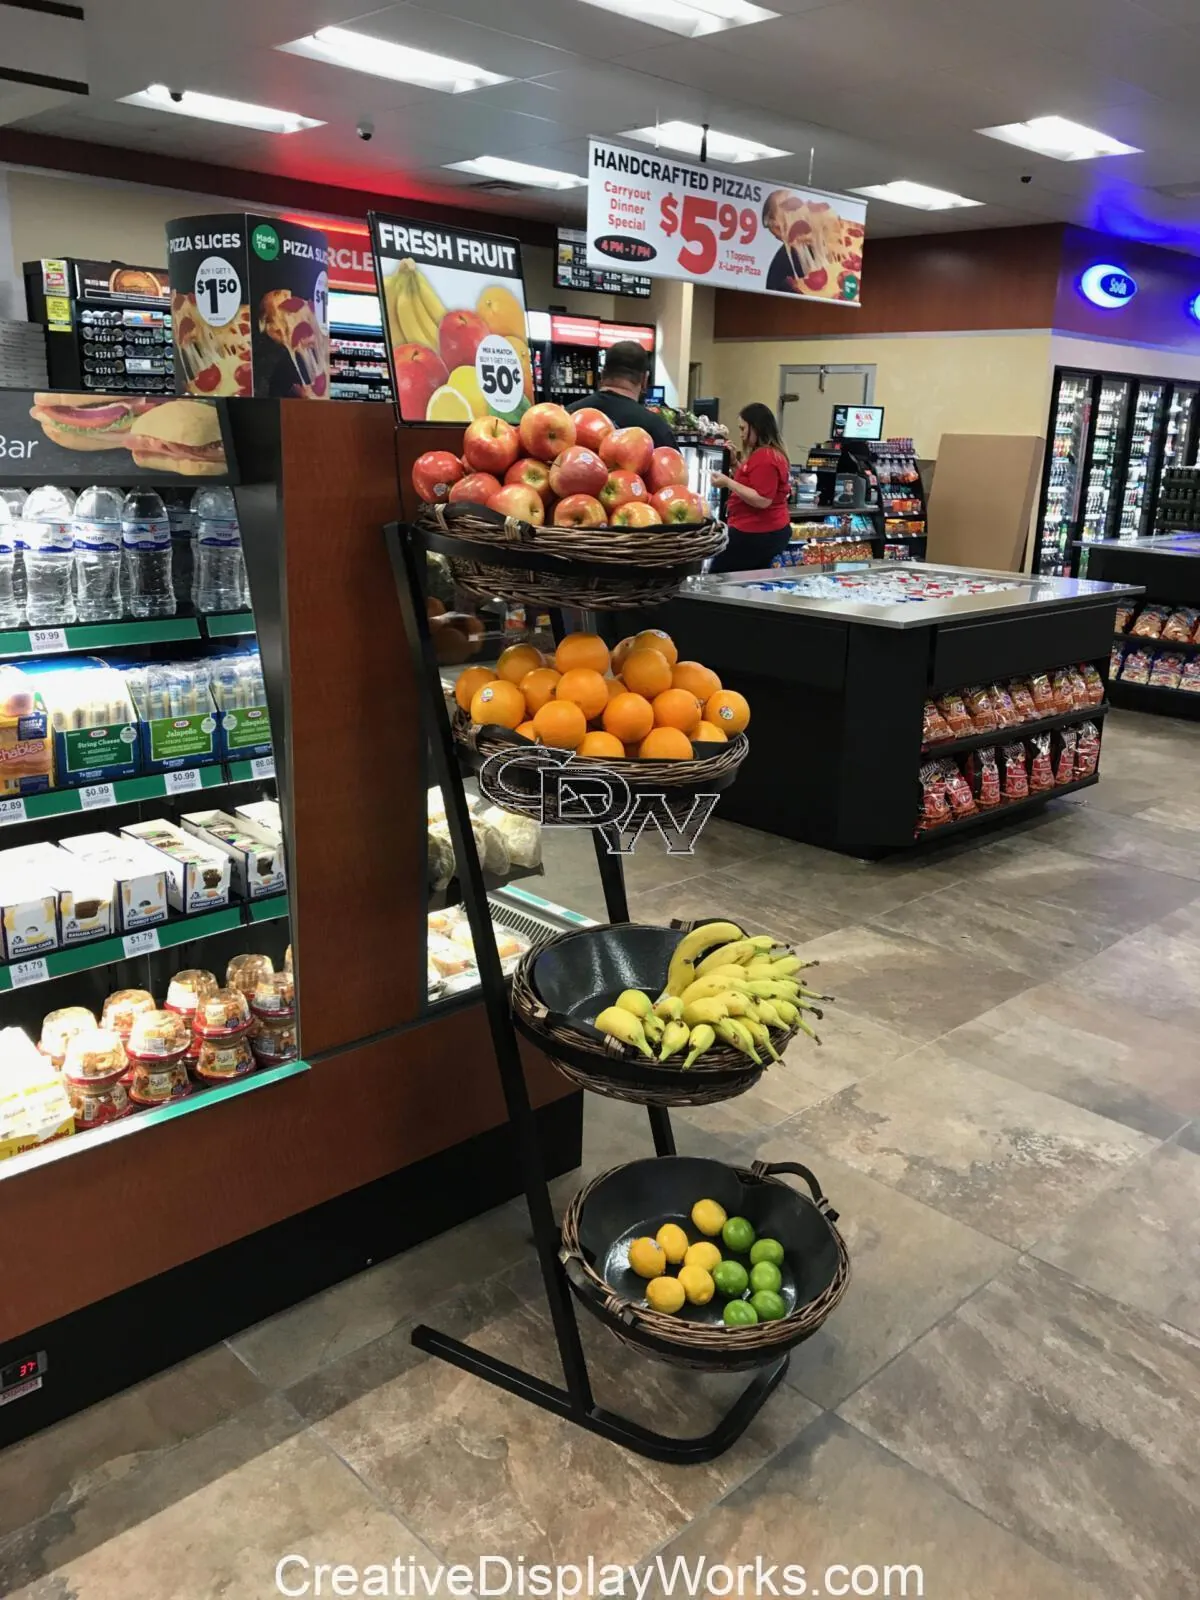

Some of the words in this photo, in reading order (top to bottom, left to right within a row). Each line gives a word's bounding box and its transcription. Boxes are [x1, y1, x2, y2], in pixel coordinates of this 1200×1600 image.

[594, 148, 708, 190] HANDCRAFTED
[713, 176, 762, 202] PIZZAS
[604, 181, 651, 200] Carryout
[610, 199, 645, 215] Dinner
[608, 214, 645, 231] Special
[169, 236, 193, 253] PIZZA
[194, 233, 241, 250] SLICES
[256, 233, 276, 244] Made
[256, 242, 267, 250] To
[378, 222, 453, 260] FRESH
[457, 237, 516, 270] FRUIT
[282, 239, 315, 260] PIZZA
[601, 240, 609, 250] 4
[609, 240, 624, 254] PM
[630, 244, 635, 256] 7
[637, 244, 651, 258] PM
[327, 247, 375, 272] RCLE
[730, 250, 755, 265] Topping
[718, 260, 743, 275] X-Large
[744, 265, 761, 276] Pizza
[0, 434, 39, 459] Bar
[34, 631, 60, 642] $0.99
[173, 771, 195, 782] $0.99
[85, 786, 110, 797] $0.99
[130, 931, 153, 944] $1.79
[17, 960, 43, 973] $1.79
